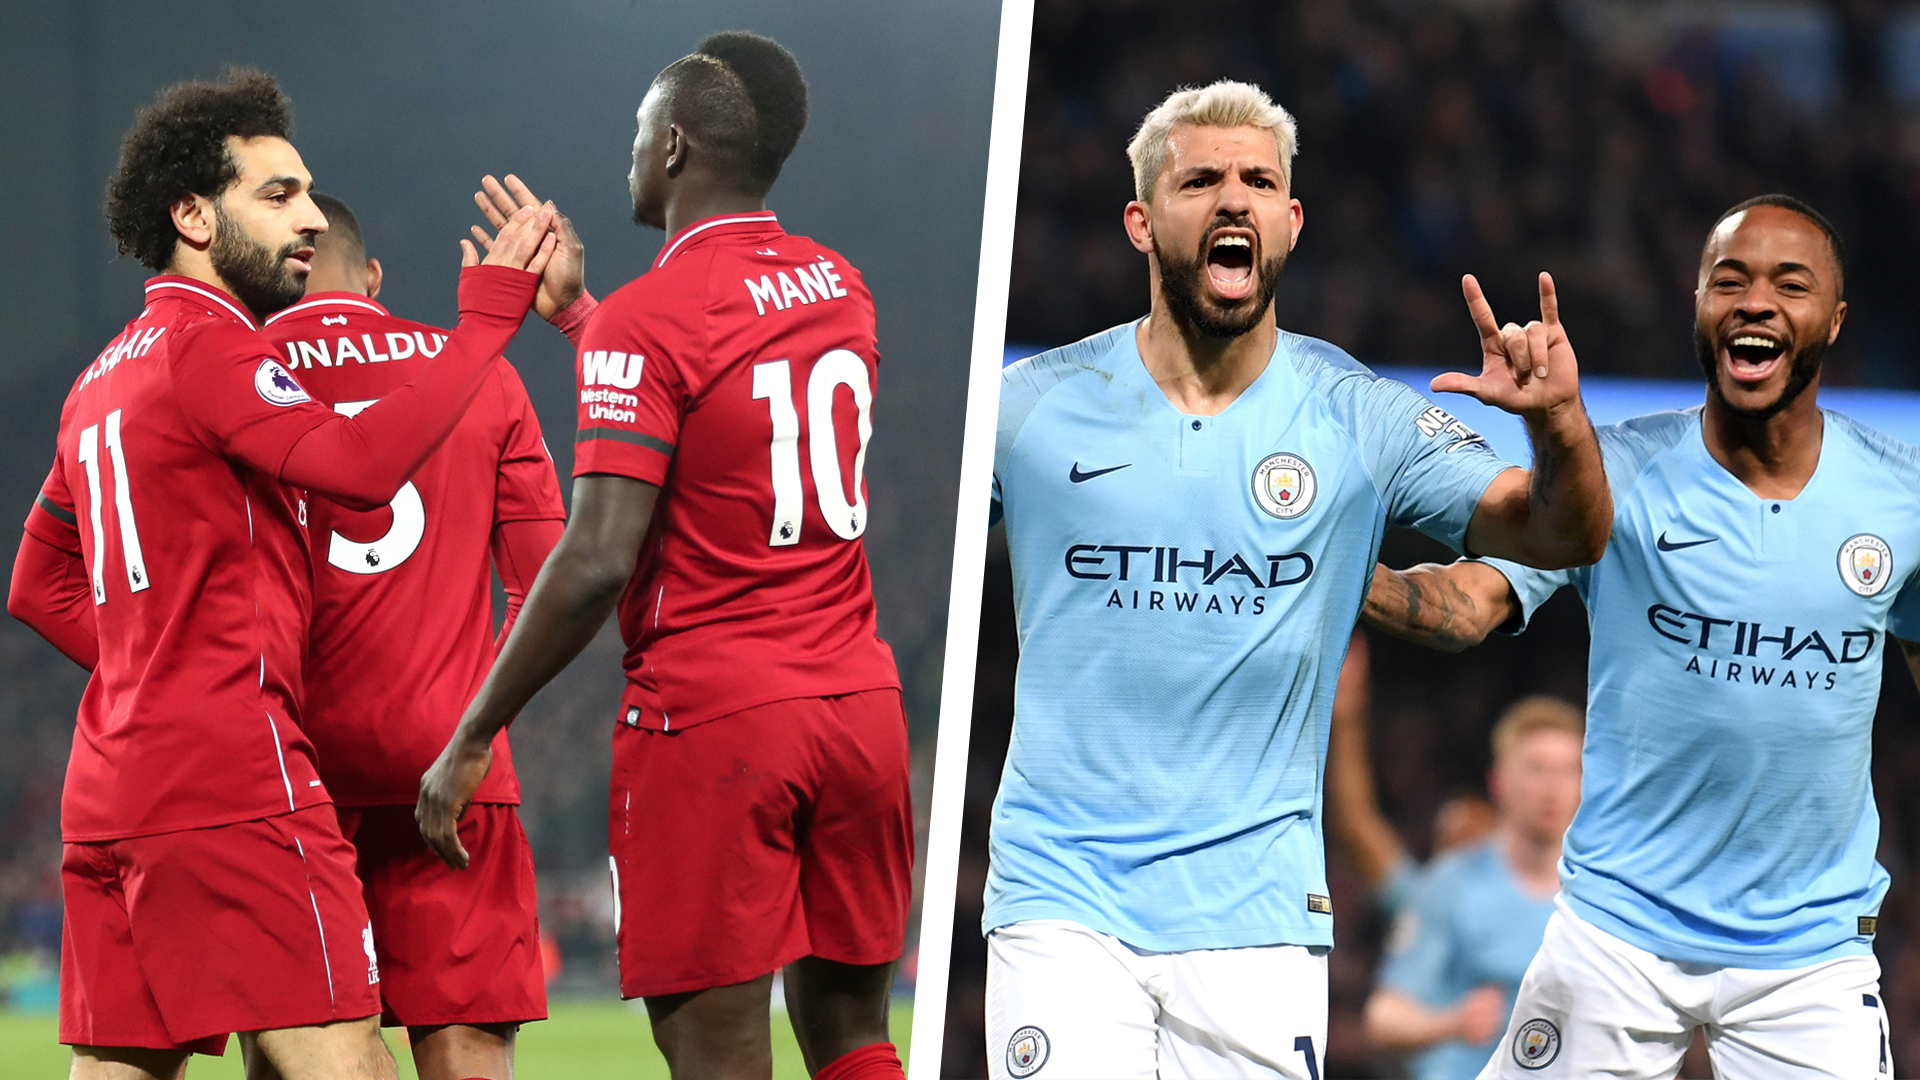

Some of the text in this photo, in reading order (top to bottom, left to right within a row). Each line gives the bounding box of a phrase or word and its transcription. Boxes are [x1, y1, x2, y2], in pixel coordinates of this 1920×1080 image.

[583, 350, 645, 389] WU
[581, 388, 638, 407] Western
[589, 403, 636, 423] Union
[752, 348, 873, 547] 10
[1260, 457, 1310, 478] MANCHESTER
[78, 408, 151, 606] 11
[1065, 544, 1314, 588] ETIHAD
[1845, 538, 1889, 559] MANCHESTER
[1106, 588, 1267, 616] AIRWAYS
[1647, 603, 1875, 665] ETIHAD
[1685, 655, 1838, 691] AIRWAYS
